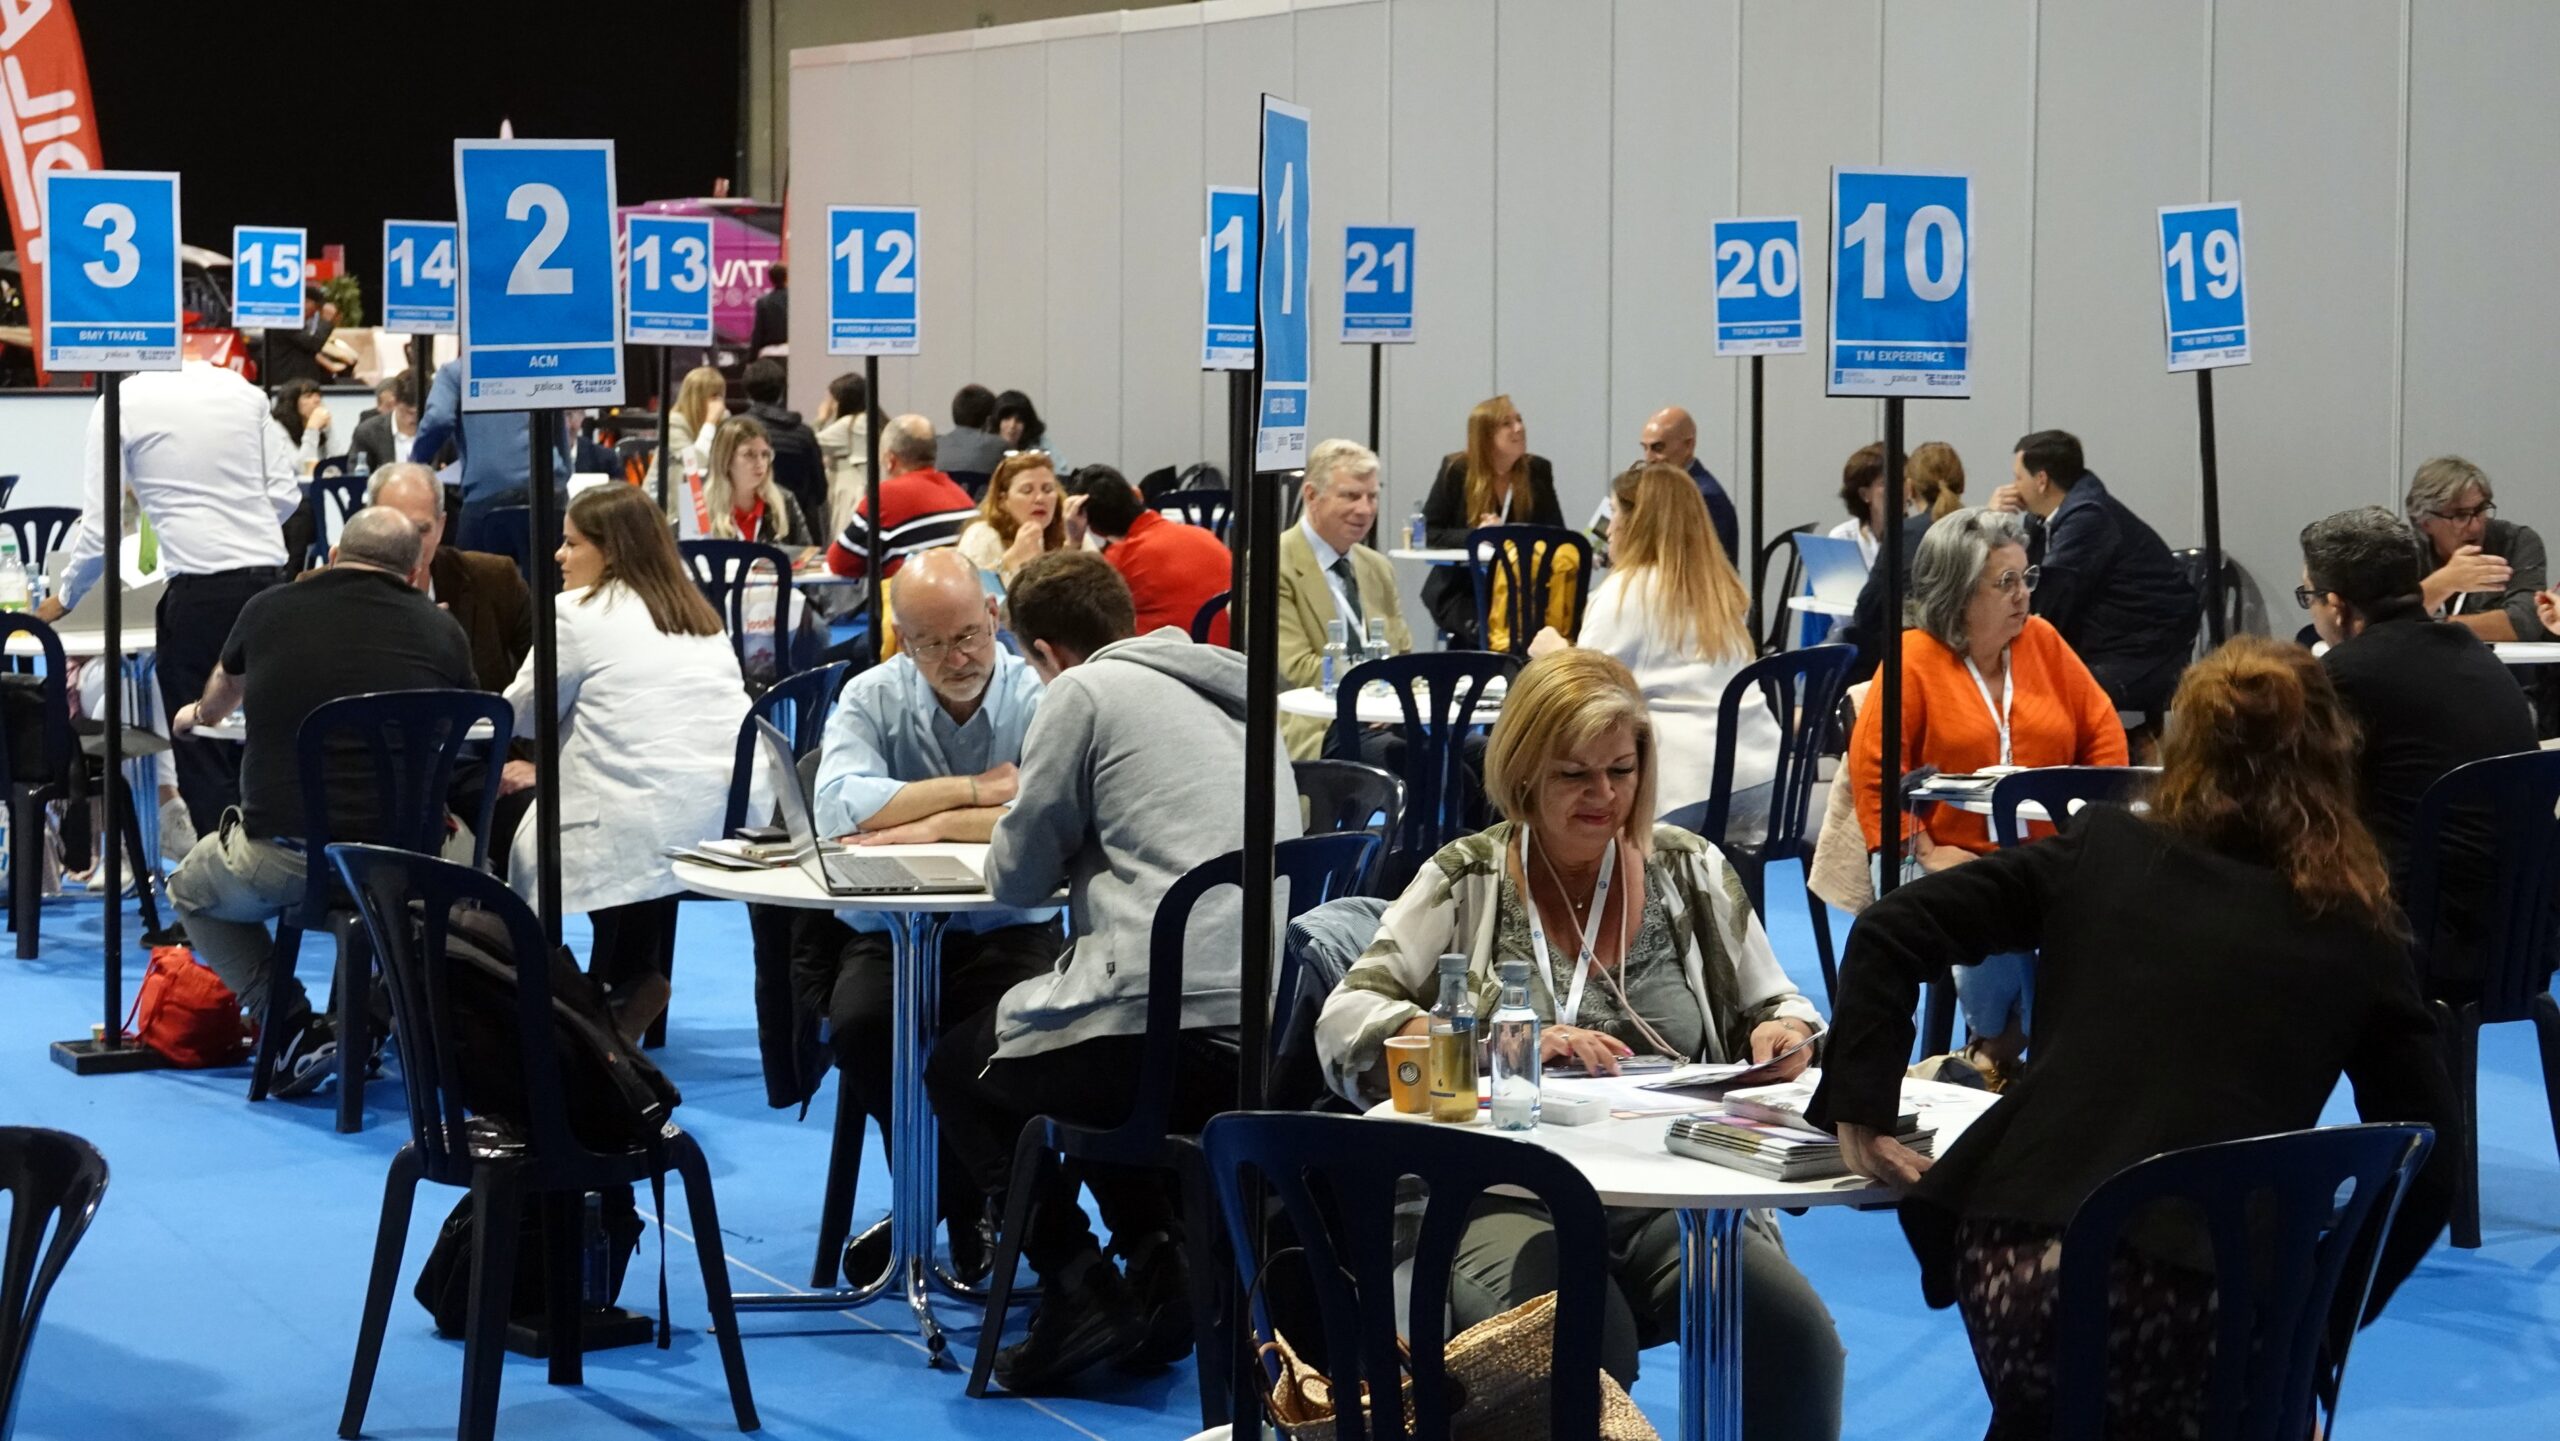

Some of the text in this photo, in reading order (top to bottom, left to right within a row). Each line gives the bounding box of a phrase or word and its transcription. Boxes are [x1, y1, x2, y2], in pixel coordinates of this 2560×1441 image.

[82, 202, 141, 289] 3
[239, 241, 300, 289] 15
[389, 237, 457, 289] 14
[505, 182, 574, 296] 2
[633, 234, 708, 294] 13
[834, 228, 914, 294] 12
[1275, 161, 1293, 315] 1
[1345, 240, 1408, 293] 21
[1717, 237, 1798, 299] 20
[1843, 202, 1965, 302] 10
[2167, 228, 2240, 302] 19
[78, 330, 148, 341] BMY TRAVEL
[528, 354, 559, 368] ACM
[1878, 350, 1945, 363] EXPERIENCE
